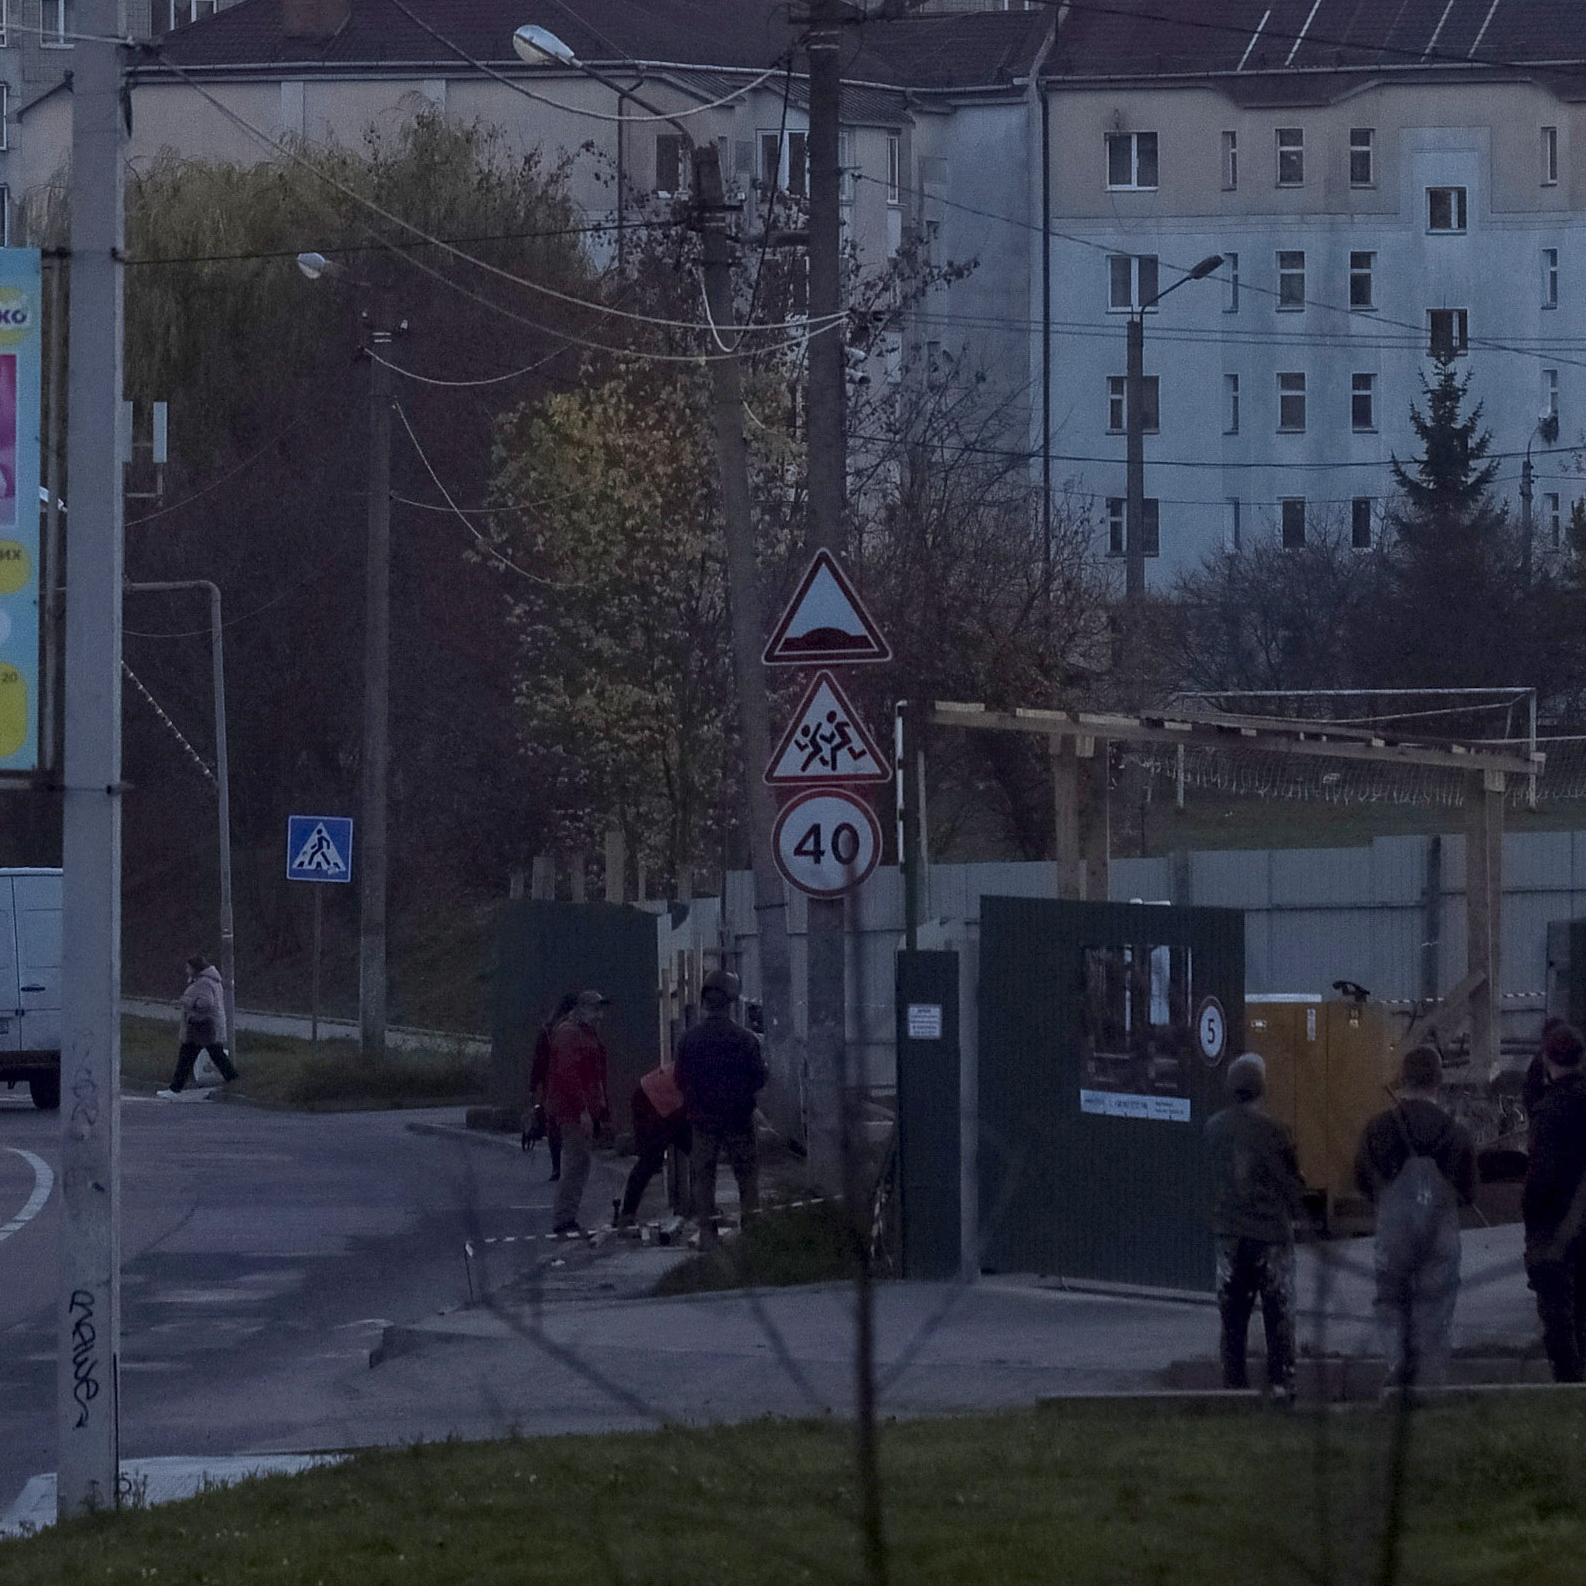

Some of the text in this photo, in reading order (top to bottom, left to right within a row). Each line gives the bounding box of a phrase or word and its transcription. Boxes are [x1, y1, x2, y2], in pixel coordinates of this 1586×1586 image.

[2, 672, 18, 683] 20
[794, 822, 860, 865] 40
[1207, 1018, 1216, 1044] 5
